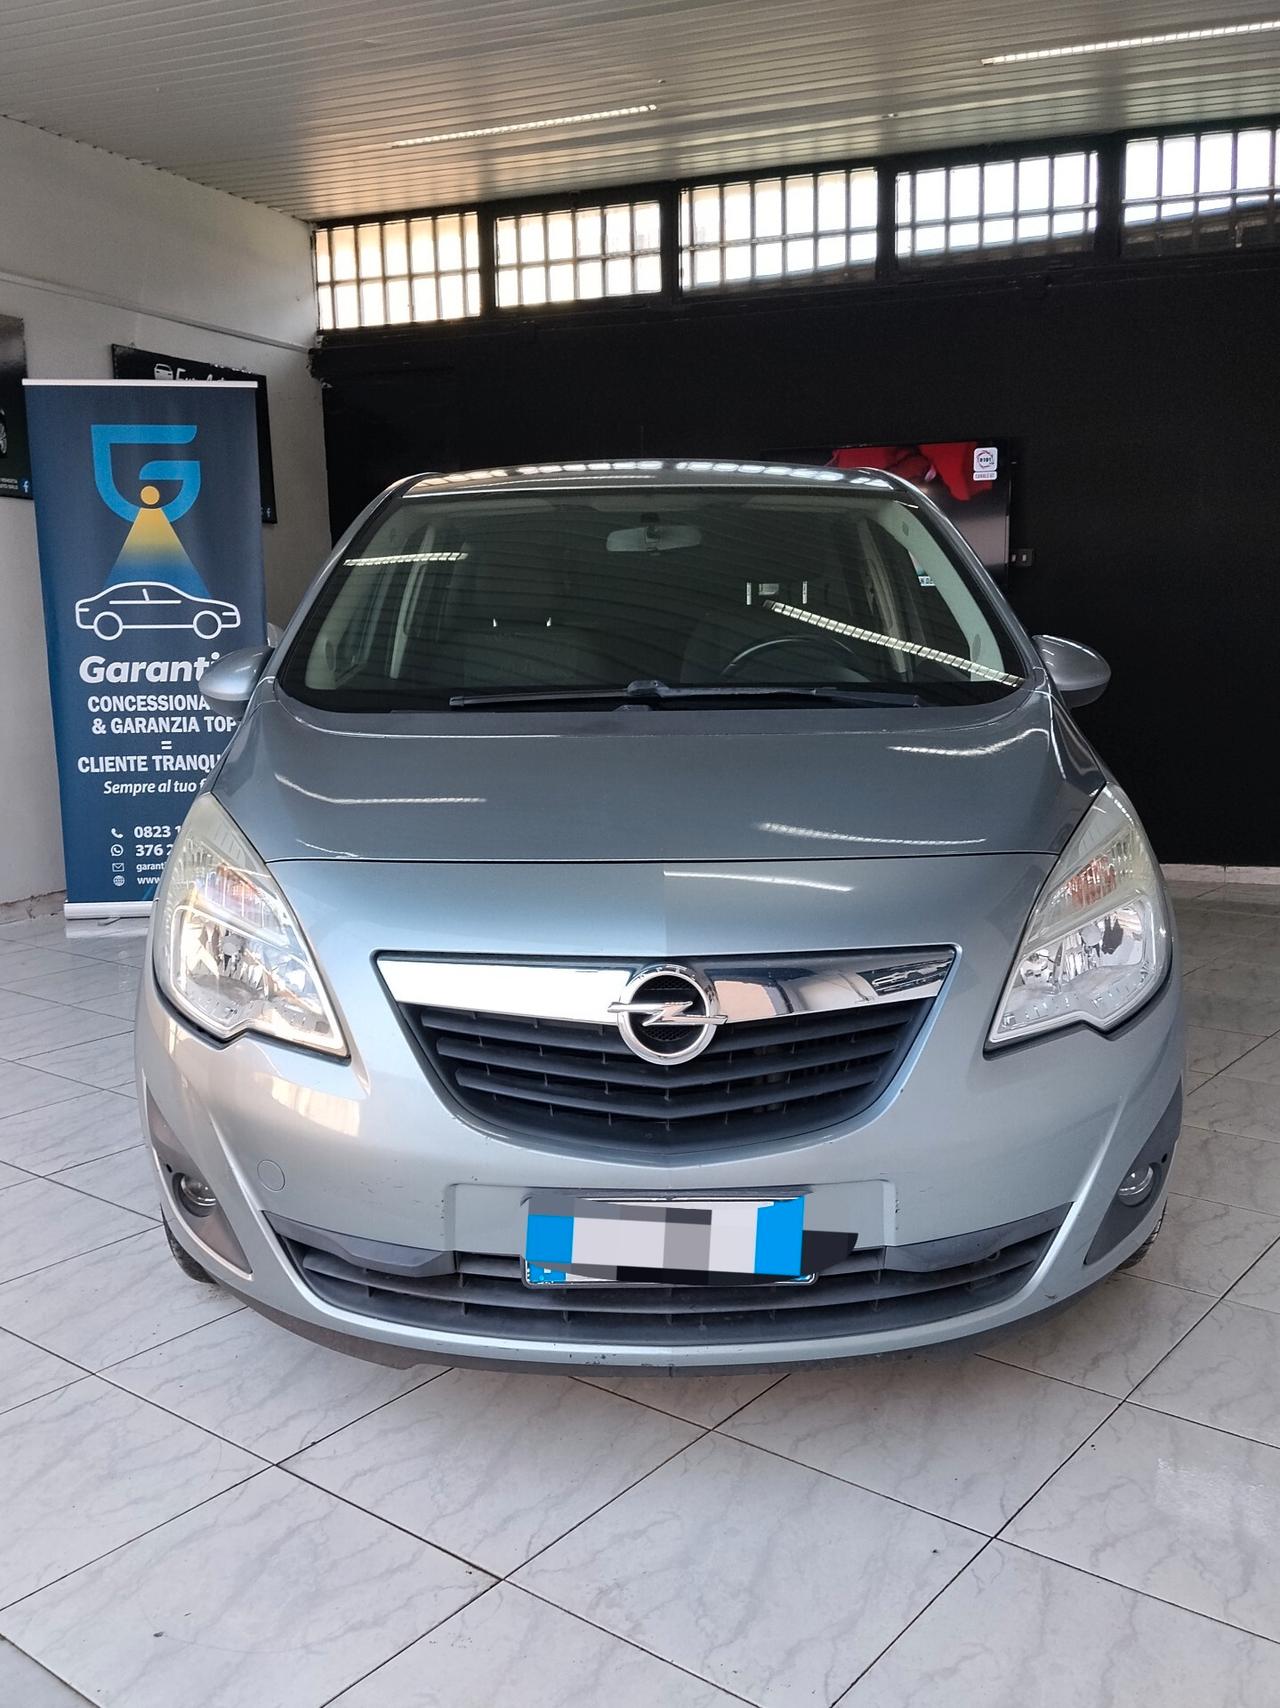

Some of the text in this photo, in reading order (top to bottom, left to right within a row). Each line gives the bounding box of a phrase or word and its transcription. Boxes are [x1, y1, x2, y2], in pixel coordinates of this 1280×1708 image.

[91, 716, 237, 735] & GARANZIA TOP
[77, 756, 149, 773] CLIENTE
[103, 780, 156, 797] Sempre
[157, 779, 172, 793] al
[173, 781, 198, 793] tuo
[133, 825, 172, 839] 0823
[135, 844, 164, 857] 376
